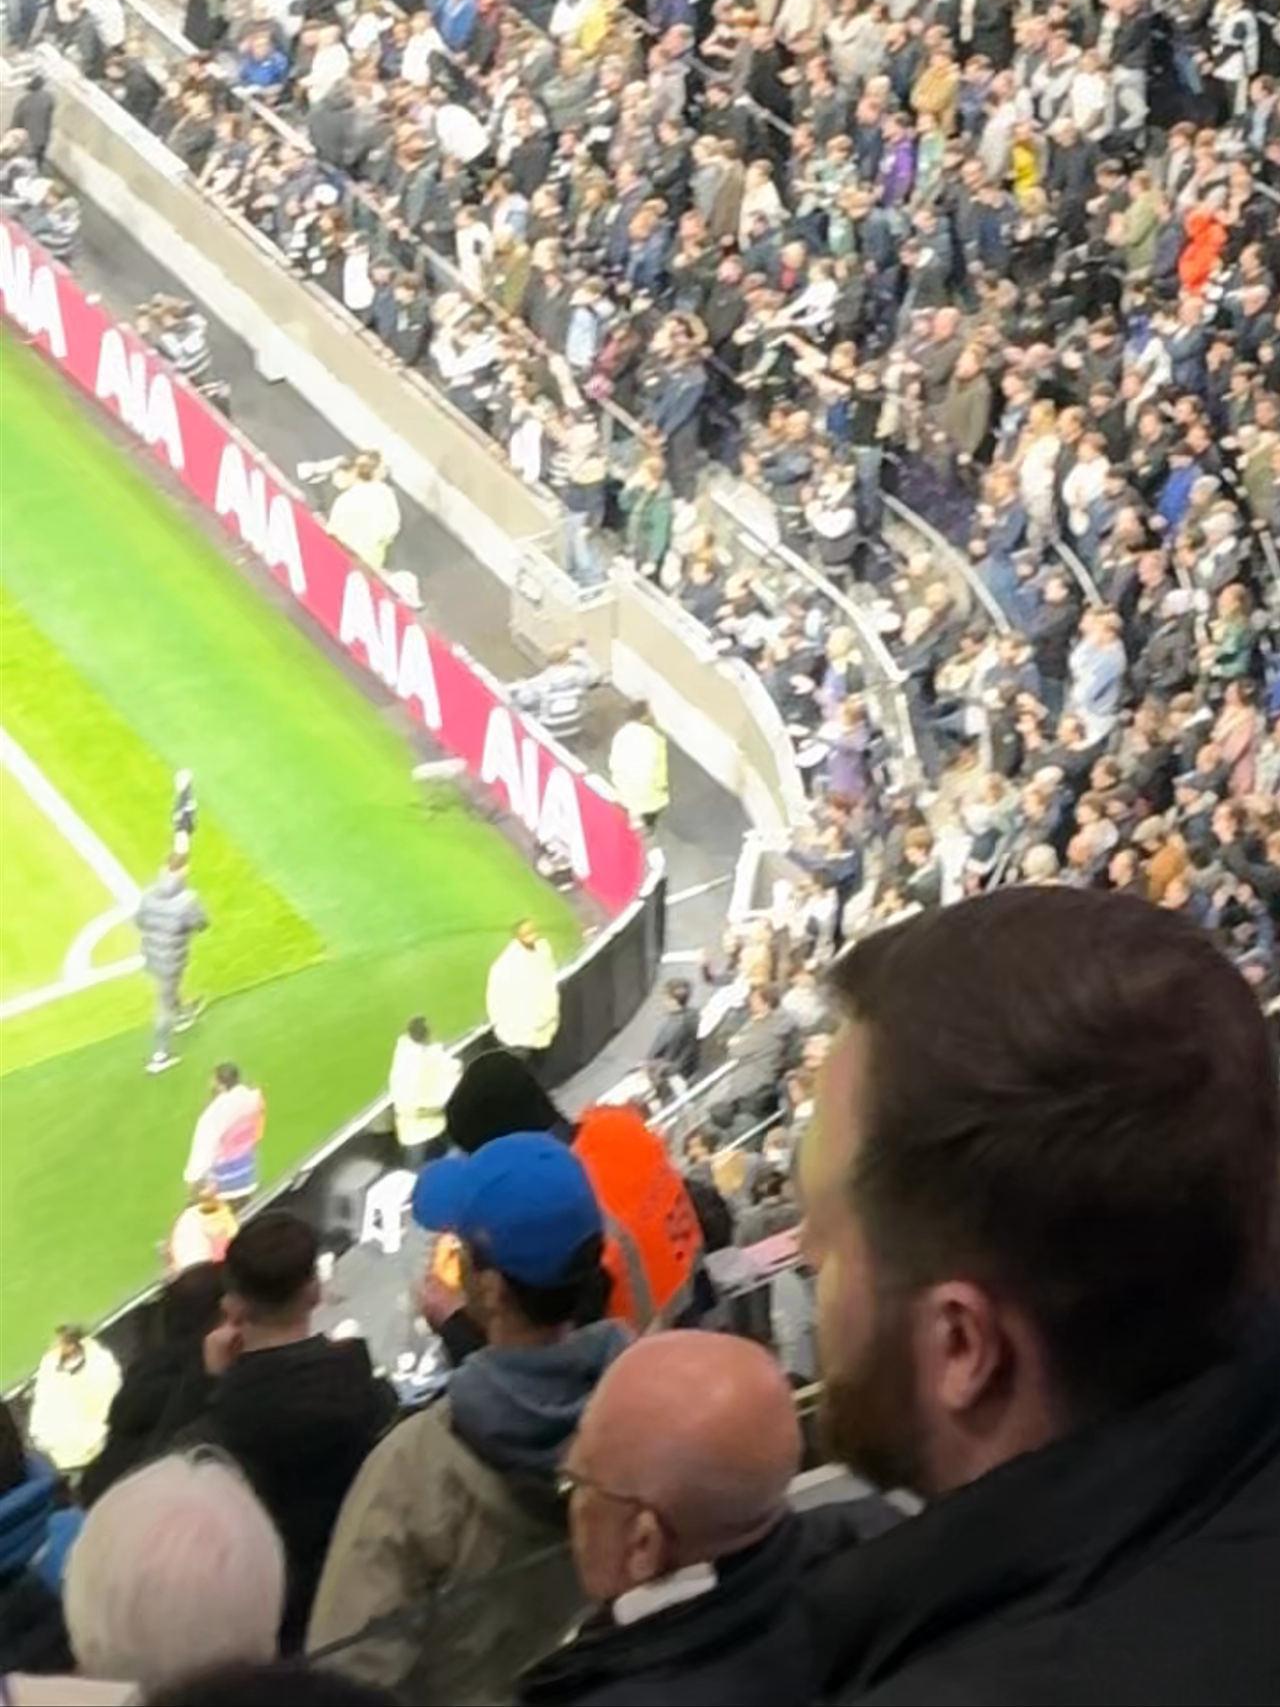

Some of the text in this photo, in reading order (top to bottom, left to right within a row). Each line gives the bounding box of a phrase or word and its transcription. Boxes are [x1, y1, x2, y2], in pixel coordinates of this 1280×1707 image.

[96, 328, 184, 470] AIA
[215, 442, 307, 595] AIA
[340, 570, 442, 731] AIA
[481, 706, 591, 880] AIA
